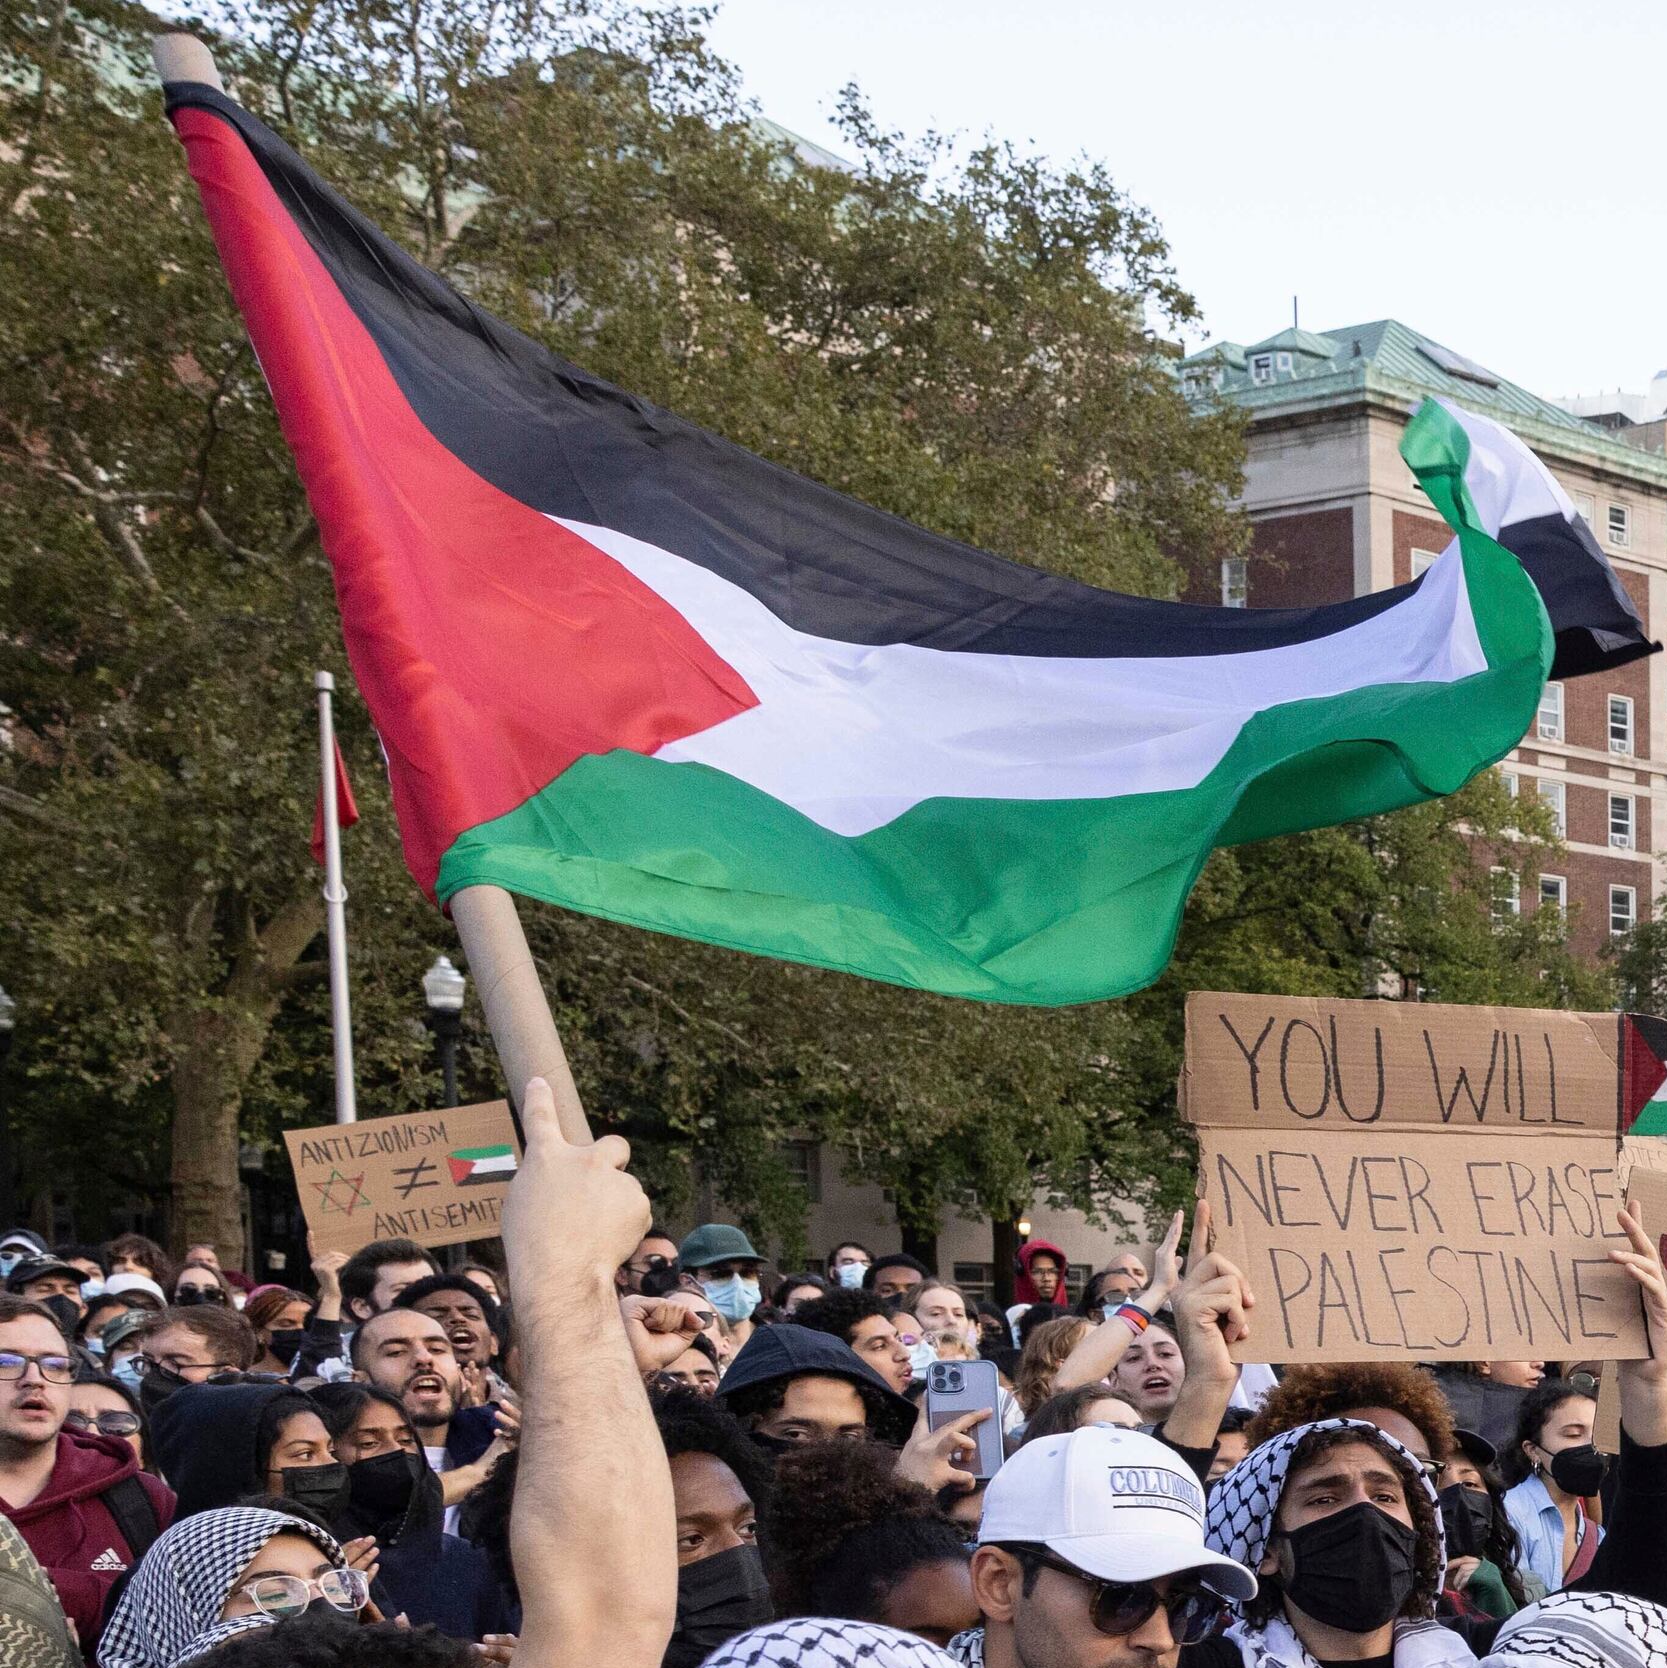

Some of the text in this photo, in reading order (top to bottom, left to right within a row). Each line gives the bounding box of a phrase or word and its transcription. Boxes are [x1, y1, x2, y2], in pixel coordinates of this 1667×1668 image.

[1218, 1013, 1586, 1124] YOU WILL
[299, 1120, 450, 1166] ANTIZIONISM
[373, 1196, 504, 1239] ANTISEMIT
[1216, 1151, 1628, 1239] NEVER ERASE
[1268, 1247, 1619, 1350] PALESTINE
